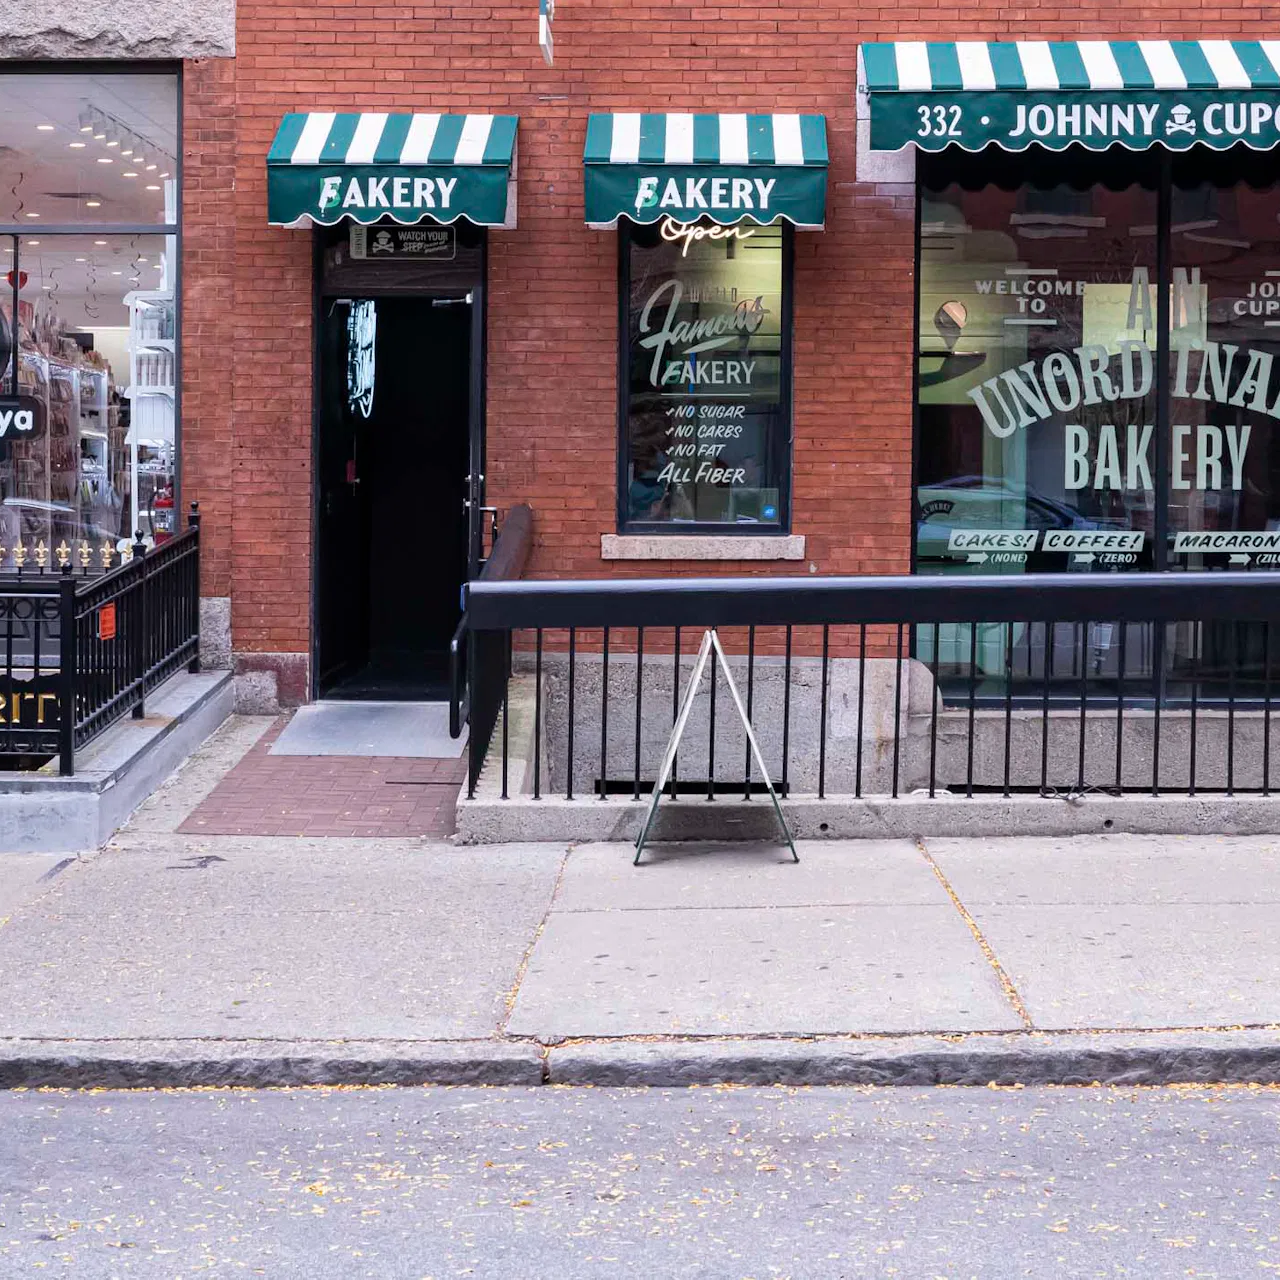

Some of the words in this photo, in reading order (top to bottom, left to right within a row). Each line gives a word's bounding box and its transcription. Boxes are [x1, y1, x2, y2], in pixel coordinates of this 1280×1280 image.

[917, 105, 962, 137] 332
[1008, 104, 1160, 137] JOHNNY
[398, 231, 426, 242] WATCH
[427, 231, 448, 242] YOUR
[660, 217, 755, 257] Open
[975, 280, 1087, 295] WELCOME
[1016, 297, 1046, 313] TO
[639, 280, 770, 387] Famous
[674, 405, 695, 418] NO
[697, 405, 746, 419] SUGAR
[674, 425, 694, 438] NO
[697, 424, 743, 439] CARBS
[674, 444, 696, 457] NO
[697, 444, 726, 457] FAT
[695, 461, 746, 484] FIBER
[953, 534, 1035, 548] CAKES!
[1048, 533, 1140, 549] COFFEE!
[990, 553, 1028, 564] (NONE)
[1099, 553, 1138, 564] (ZERO)
